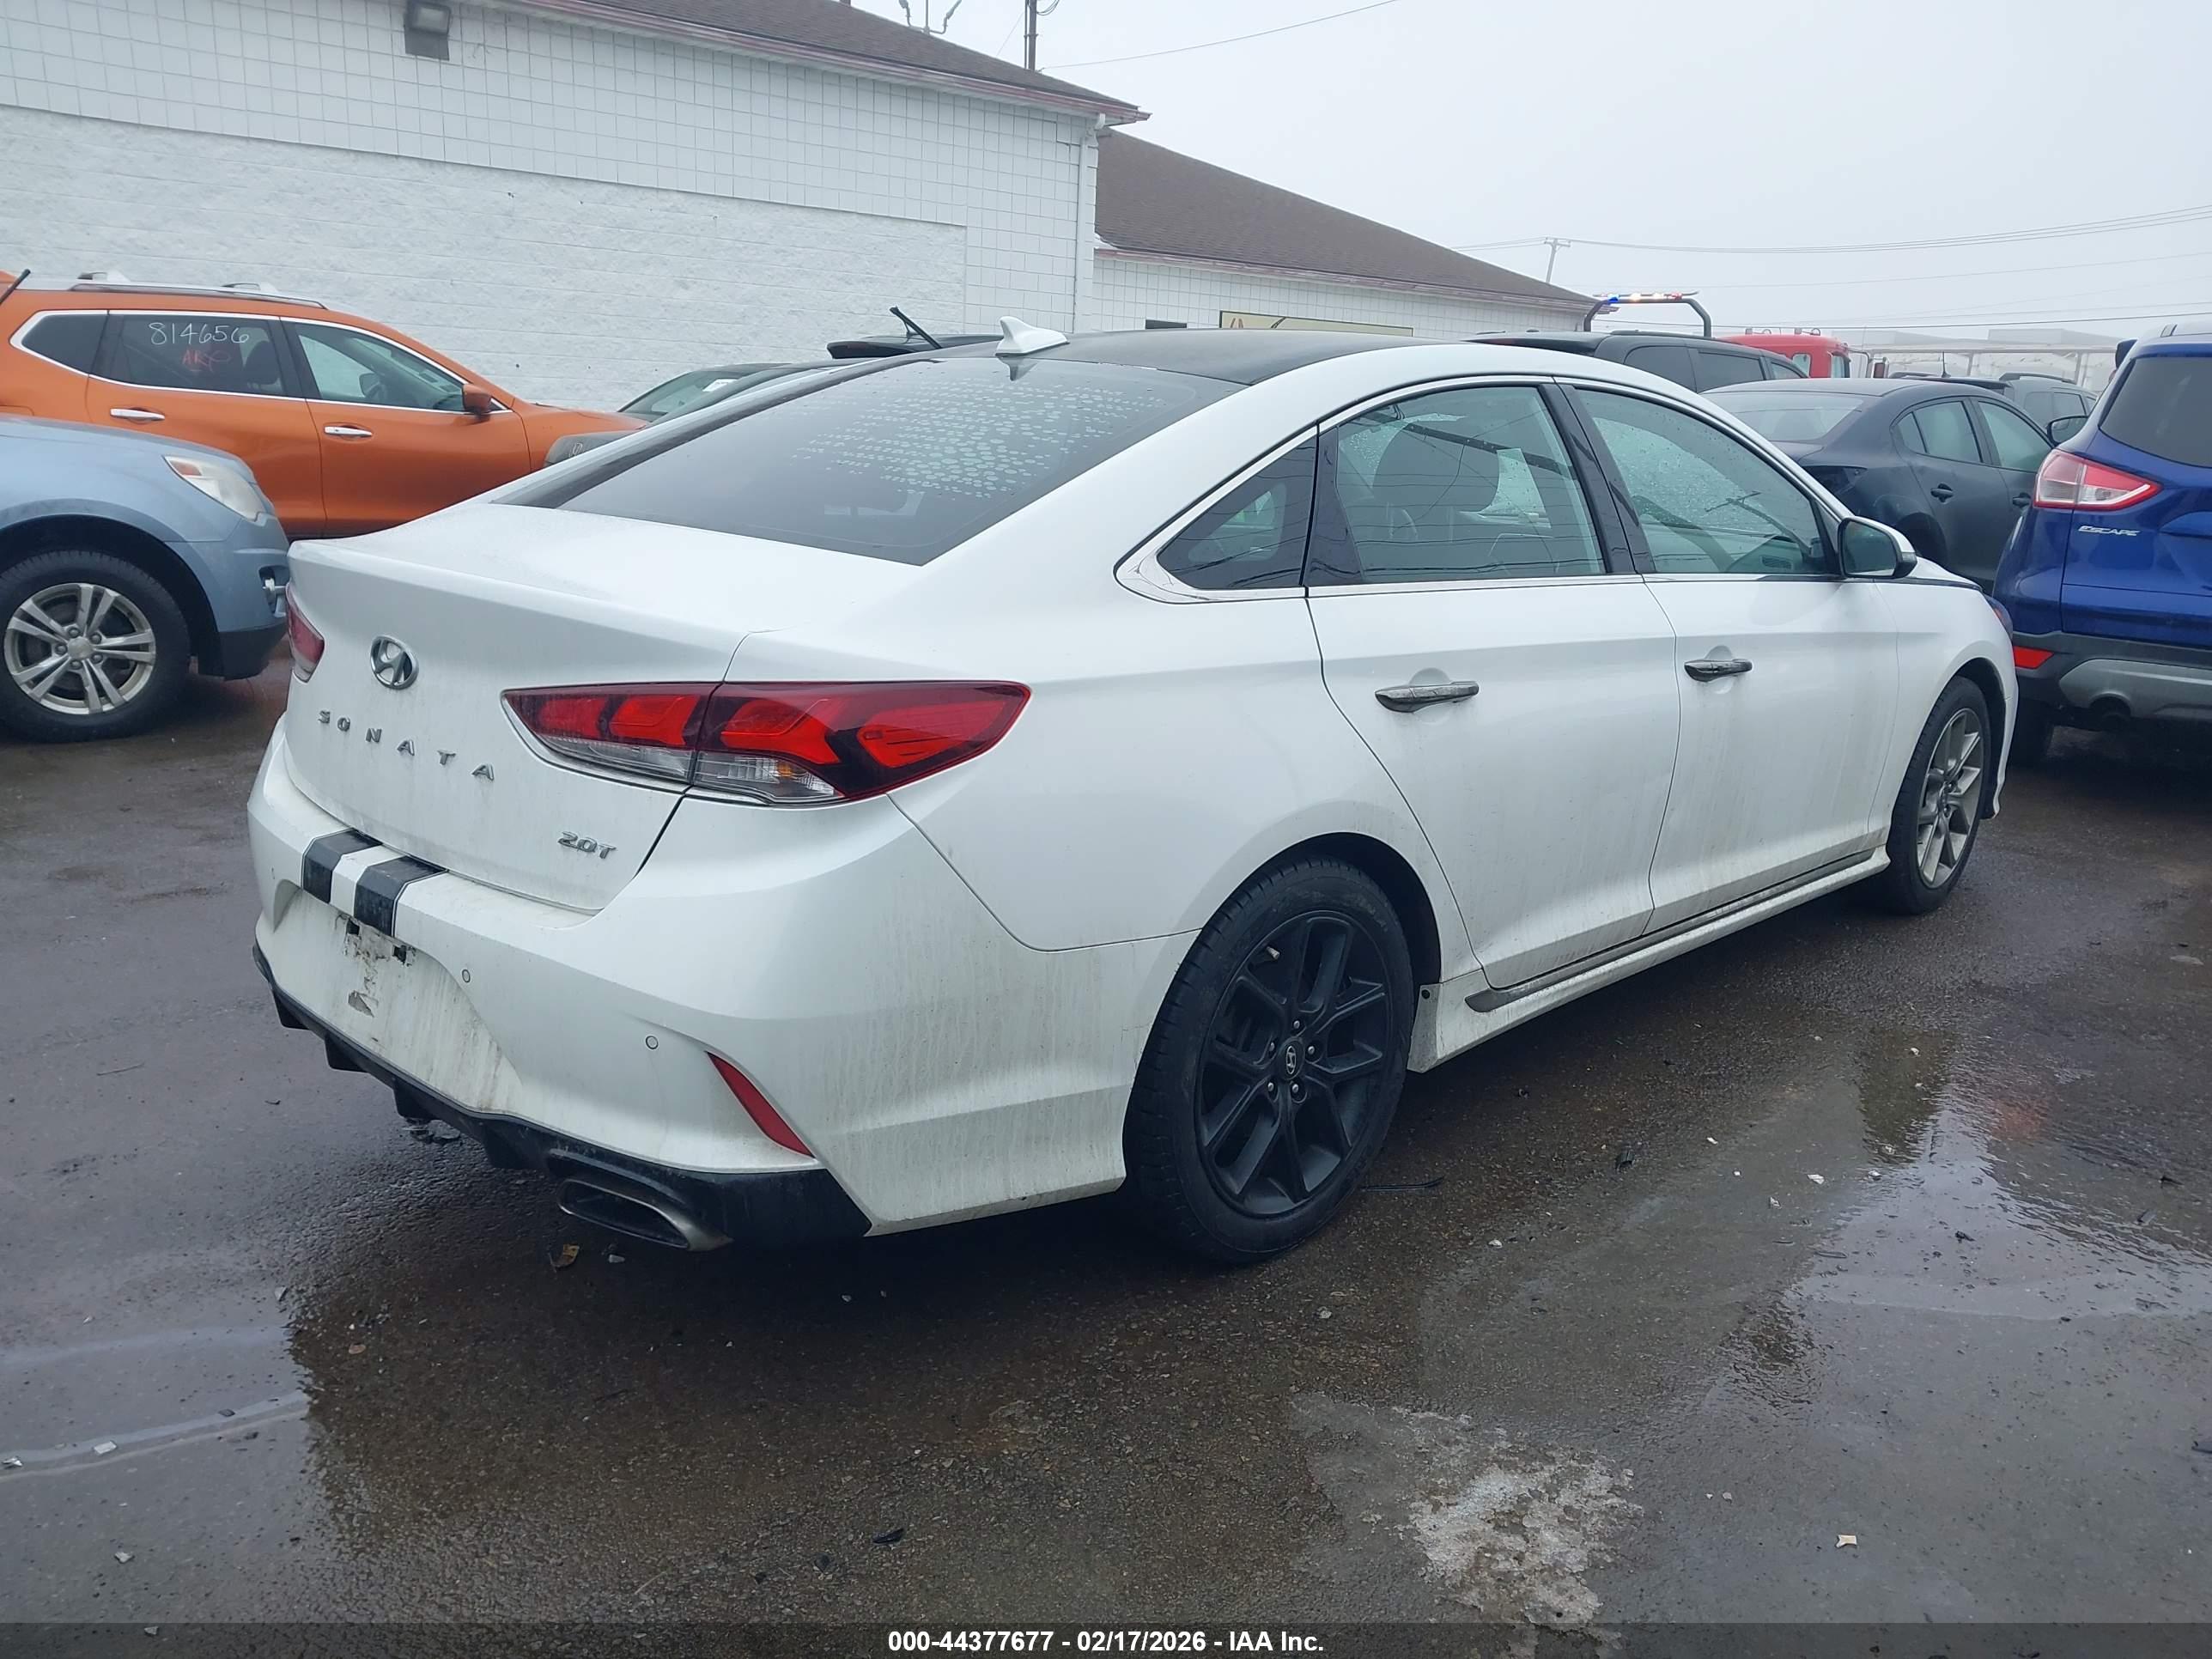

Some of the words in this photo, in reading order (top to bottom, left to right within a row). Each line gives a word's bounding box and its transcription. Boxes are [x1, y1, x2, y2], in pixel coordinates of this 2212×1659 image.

[149, 322, 249, 344] 814656
[2078, 525, 2141, 537] ESCAPE
[318, 710, 495, 781] SONATA
